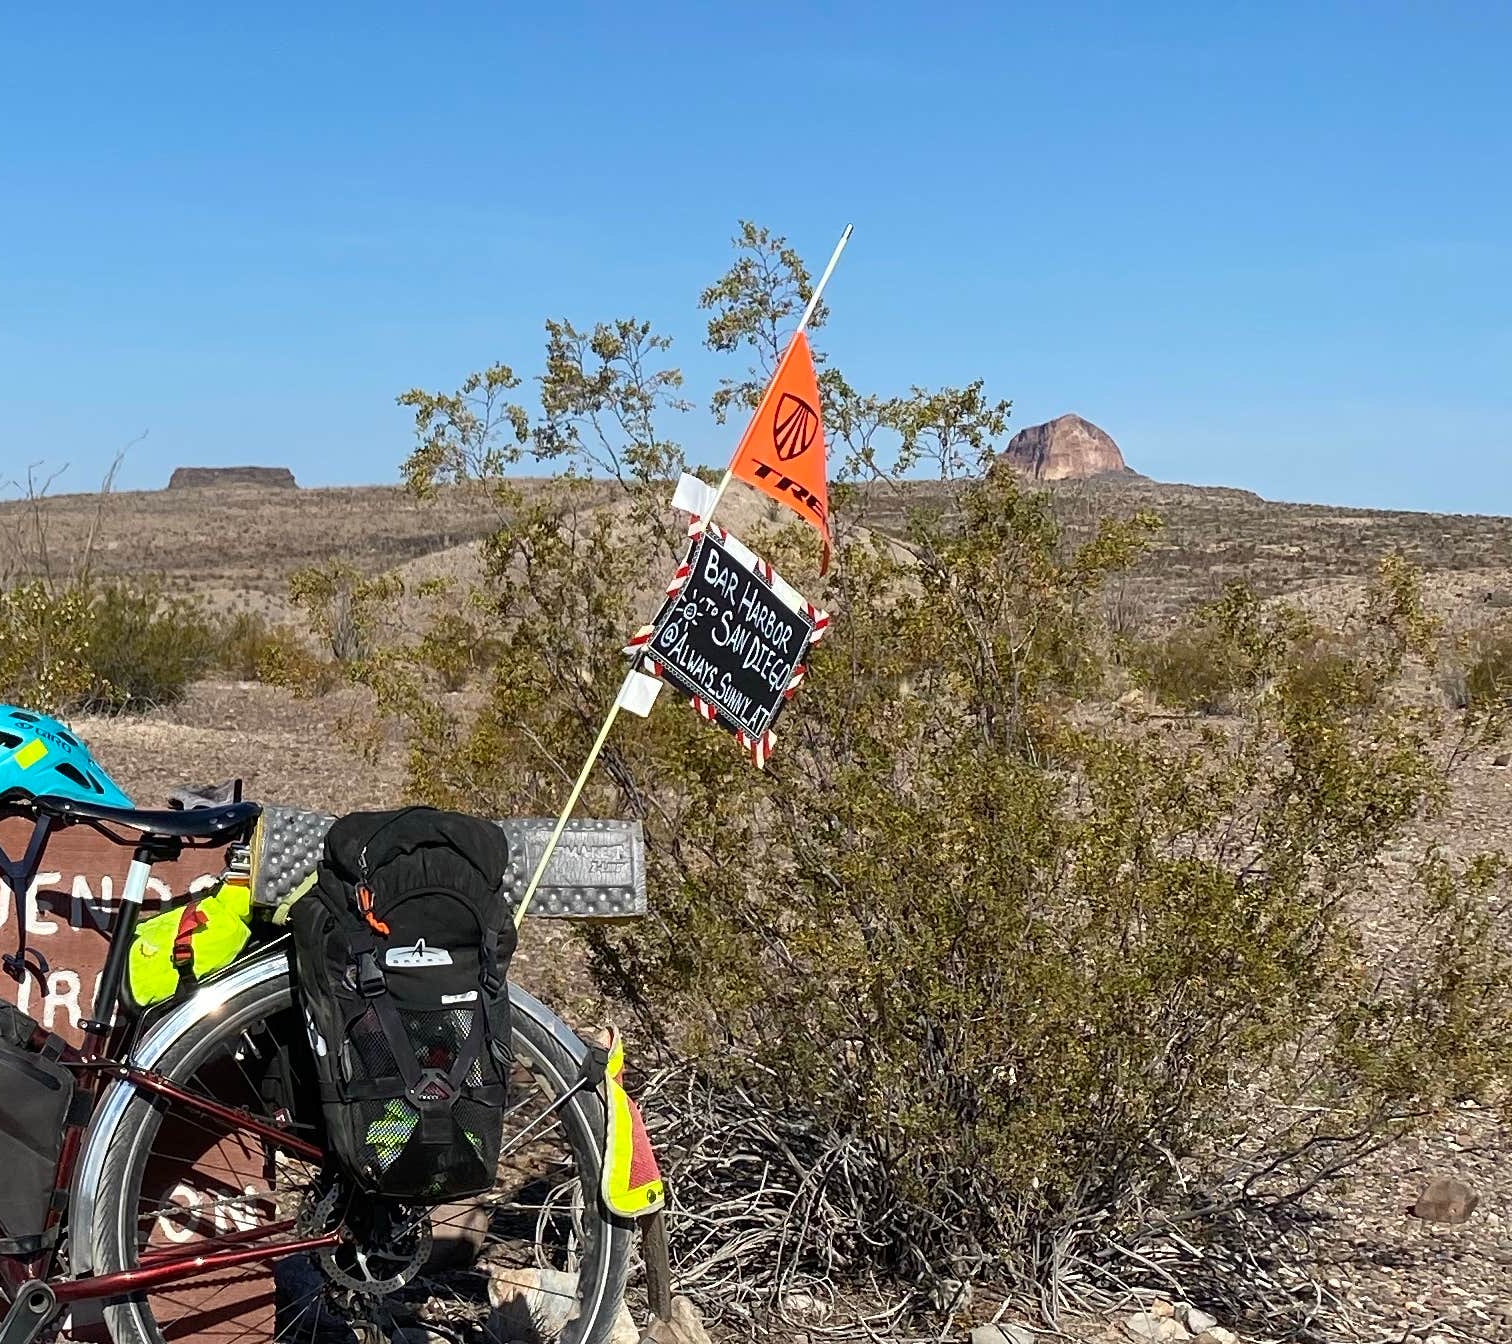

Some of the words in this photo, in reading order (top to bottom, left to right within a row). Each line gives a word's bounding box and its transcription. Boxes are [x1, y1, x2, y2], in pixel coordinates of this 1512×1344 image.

[752, 459, 824, 518] TRE
[704, 548, 738, 605] BAR
[738, 581, 793, 654] HARBOR
[711, 610, 751, 656] SAN
[742, 636, 792, 692] DIEGO
